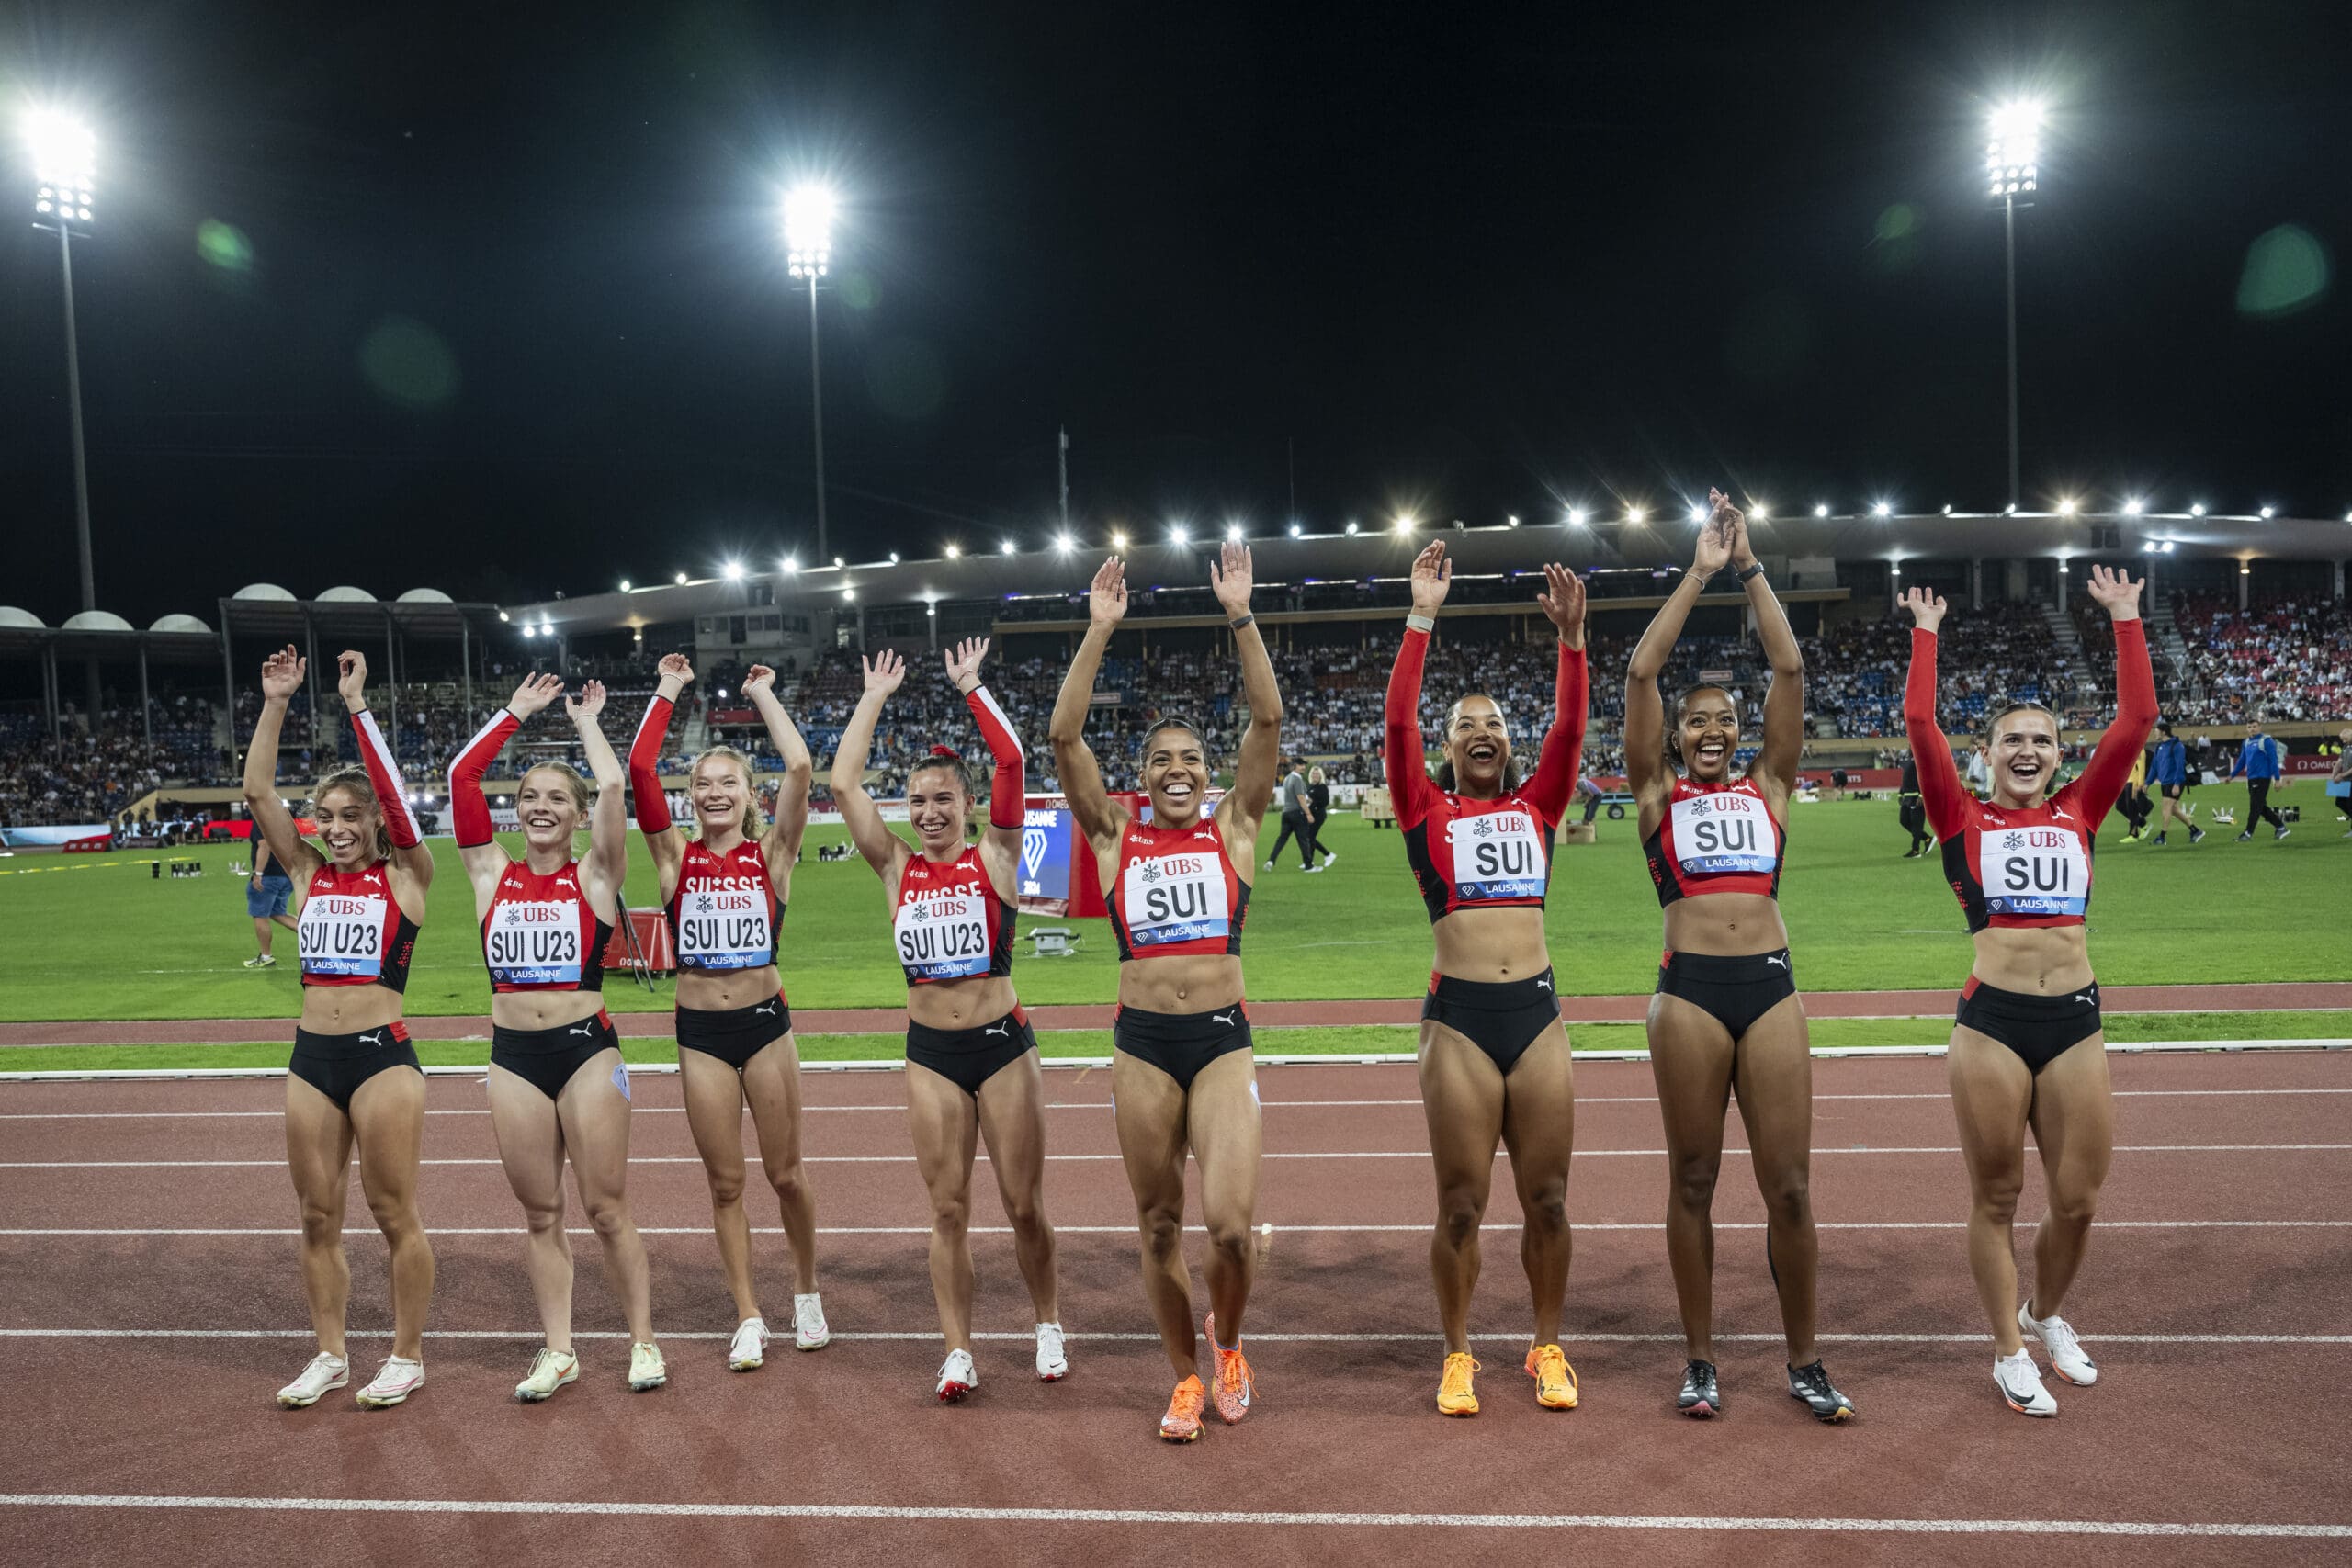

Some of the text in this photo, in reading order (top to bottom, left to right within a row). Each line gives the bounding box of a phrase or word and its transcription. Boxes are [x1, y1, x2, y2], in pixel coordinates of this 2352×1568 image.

[2310, 761, 2337, 770] OMEG
[1052, 799, 1069, 808] OMEG
[1713, 797, 1750, 812] UBS
[1494, 817, 1526, 832] UBS
[1137, 836, 1154, 845] UBS
[1695, 819, 1756, 852] SUI
[2029, 832, 2066, 848] UBS
[1476, 840, 1533, 876] SUI
[1705, 858, 1759, 867] LAUSANNE
[1164, 858, 1203, 876] UBS
[2004, 856, 2069, 891] SUI
[1486, 883, 1535, 893] LAUSANNE
[329, 900, 365, 916] UBS
[717, 896, 752, 909] UBS
[932, 901, 967, 917] UBS
[1146, 882, 1208, 922] SUI
[2014, 899, 2069, 909] LAUSANNE
[523, 908, 560, 922] UBS
[300, 922, 377, 954] SUI U23
[684, 917, 766, 950] SUI U23
[1159, 924, 1210, 938] LAUSANNE
[492, 930, 576, 963] SUI U23
[900, 922, 985, 961] SUI U23
[311, 961, 360, 970] LAUSANNE
[705, 955, 753, 965] LAUSANNE
[511, 969, 561, 978] LAUSANNE
[925, 963, 973, 976] LAUSANNE
